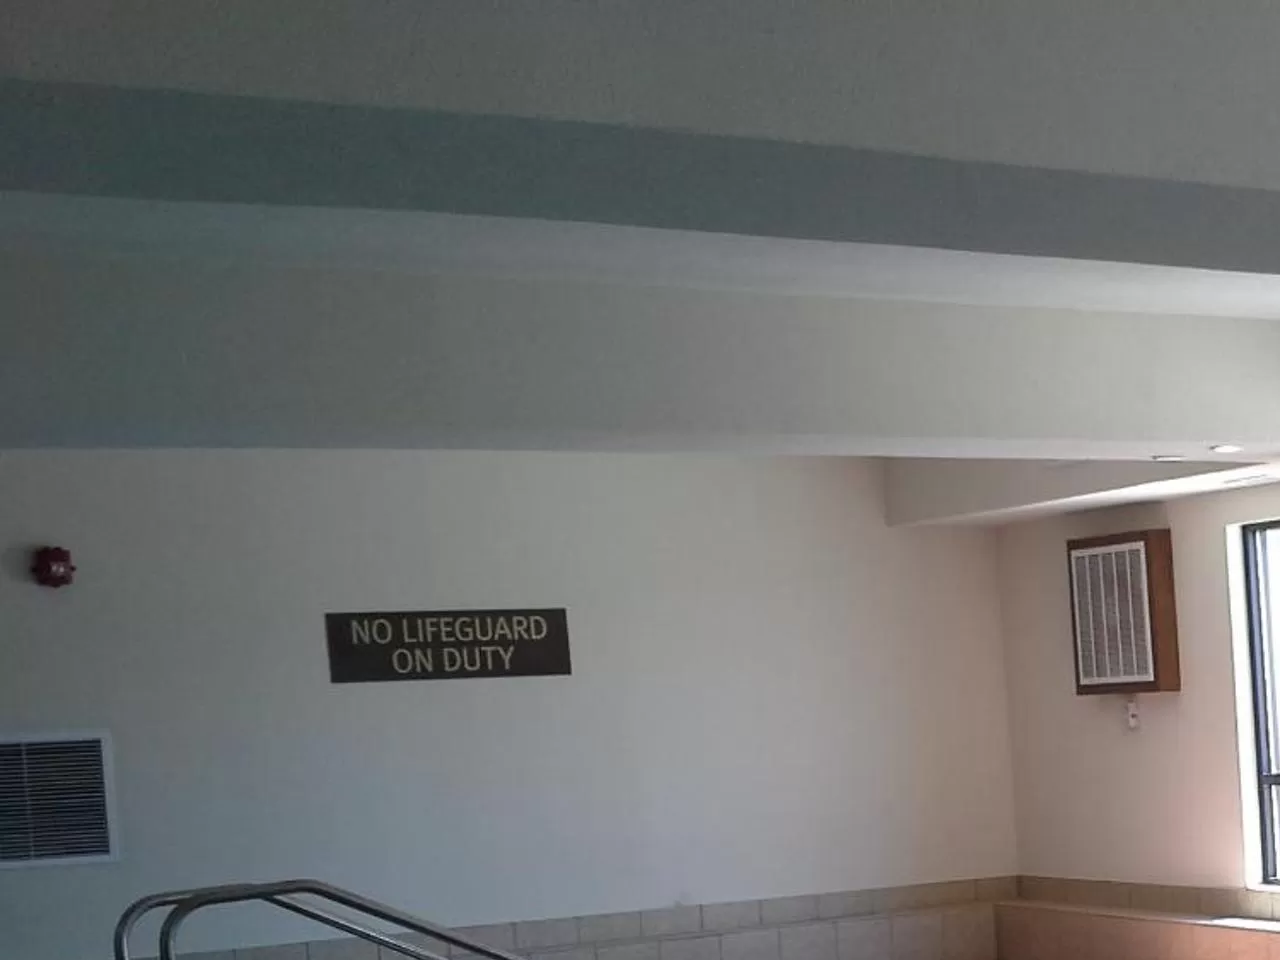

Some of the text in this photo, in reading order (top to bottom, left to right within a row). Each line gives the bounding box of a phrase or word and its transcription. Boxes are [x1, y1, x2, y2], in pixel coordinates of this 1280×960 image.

[351, 615, 548, 645] NO LIFEGUARD
[391, 646, 515, 673] ON DUTY
